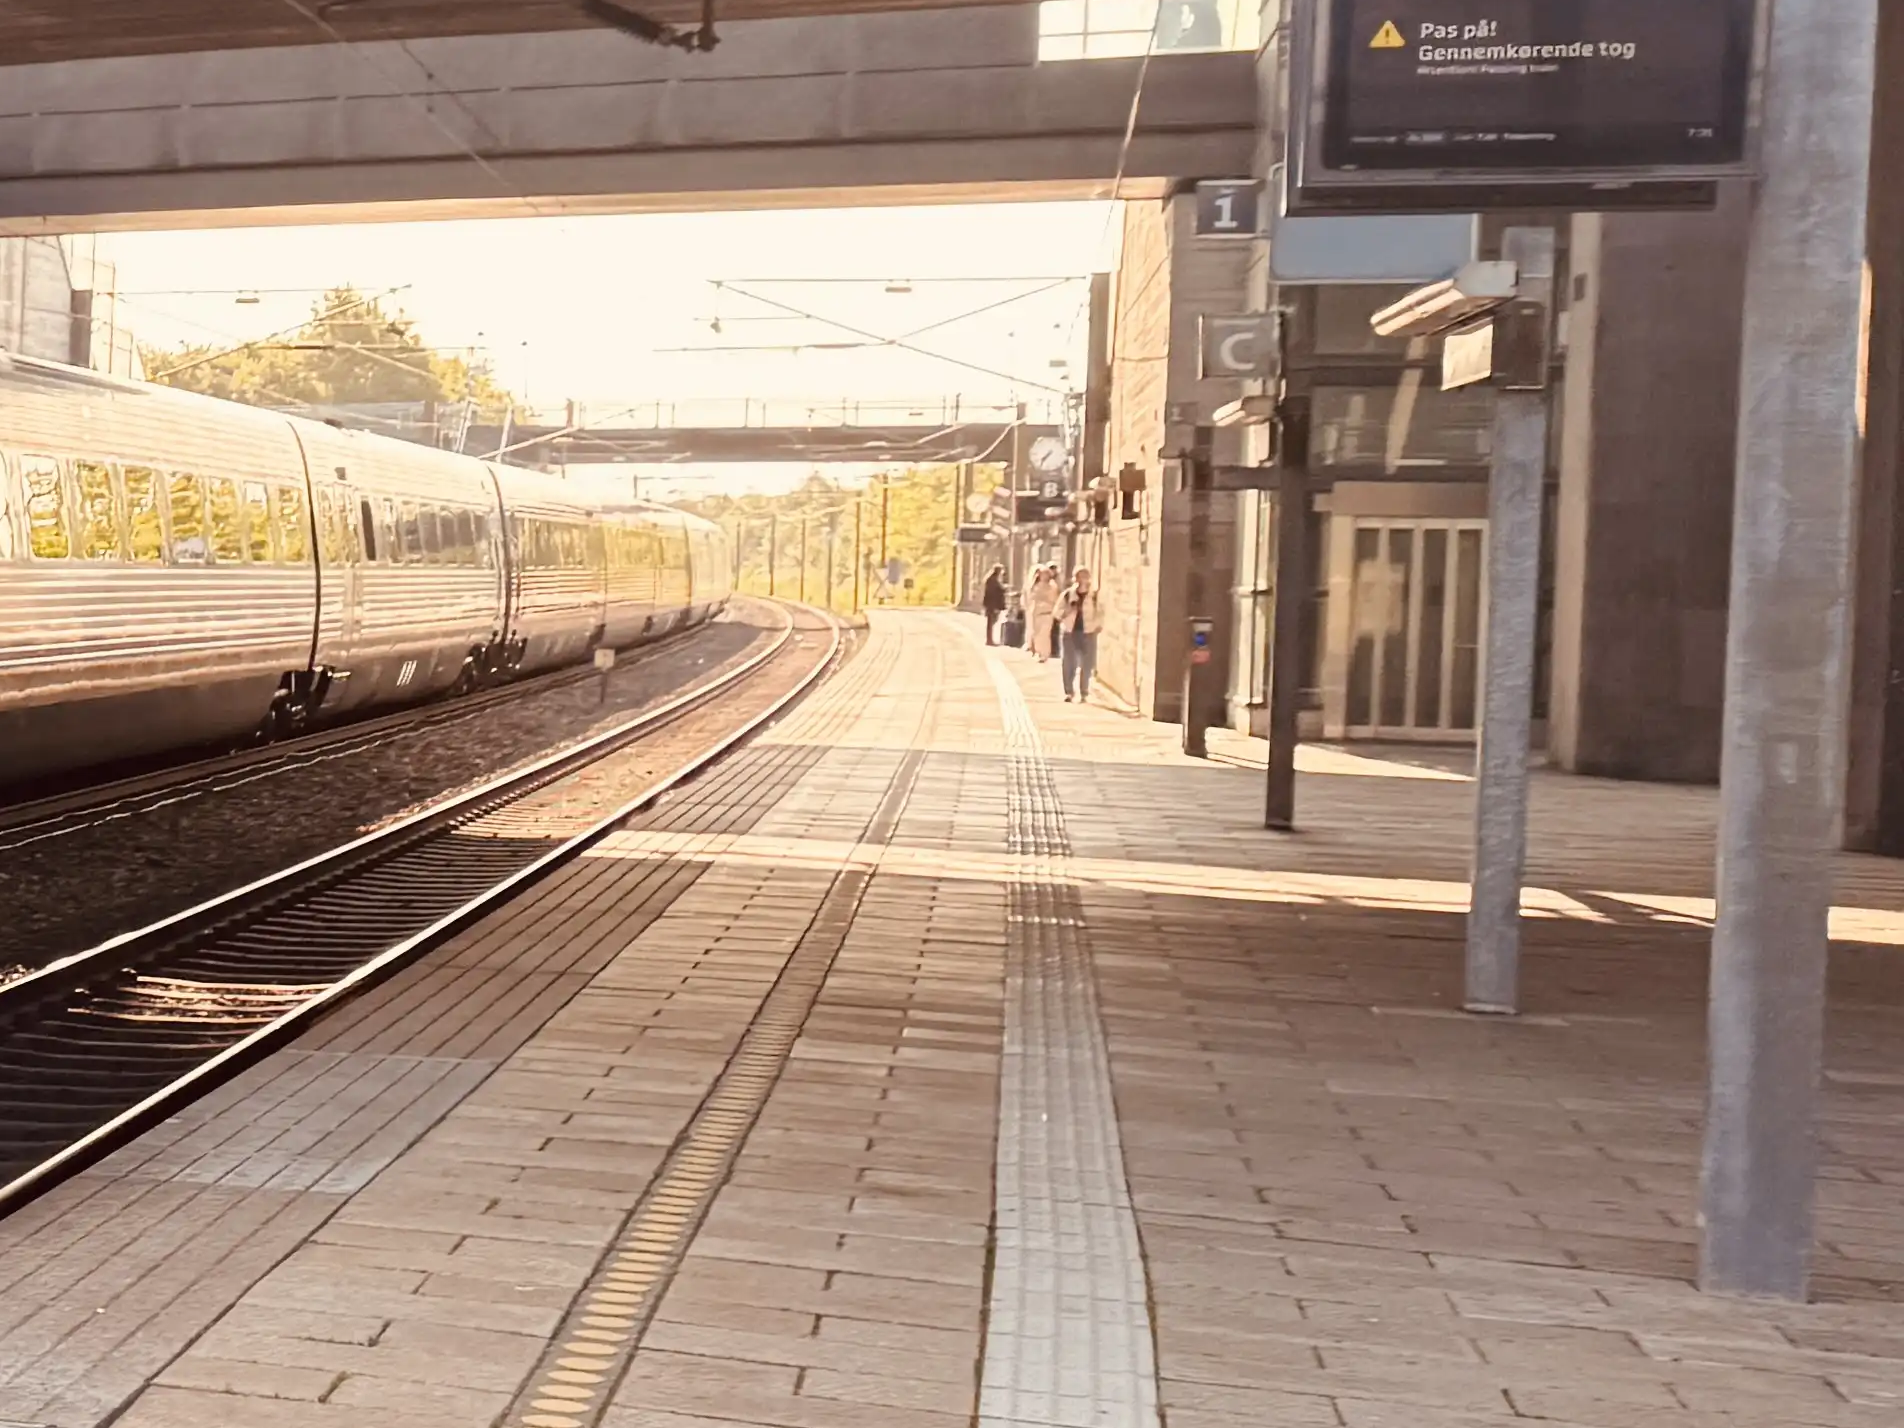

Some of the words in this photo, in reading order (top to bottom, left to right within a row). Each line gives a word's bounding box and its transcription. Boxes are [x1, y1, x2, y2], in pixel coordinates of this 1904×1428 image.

[1420, 22, 1458, 38] Pas
[1464, 19, 1498, 40] på!
[1419, 42, 1594, 61] Gennemkørende
[1599, 42, 1636, 59] tog
[1220, 332, 1256, 370] C
